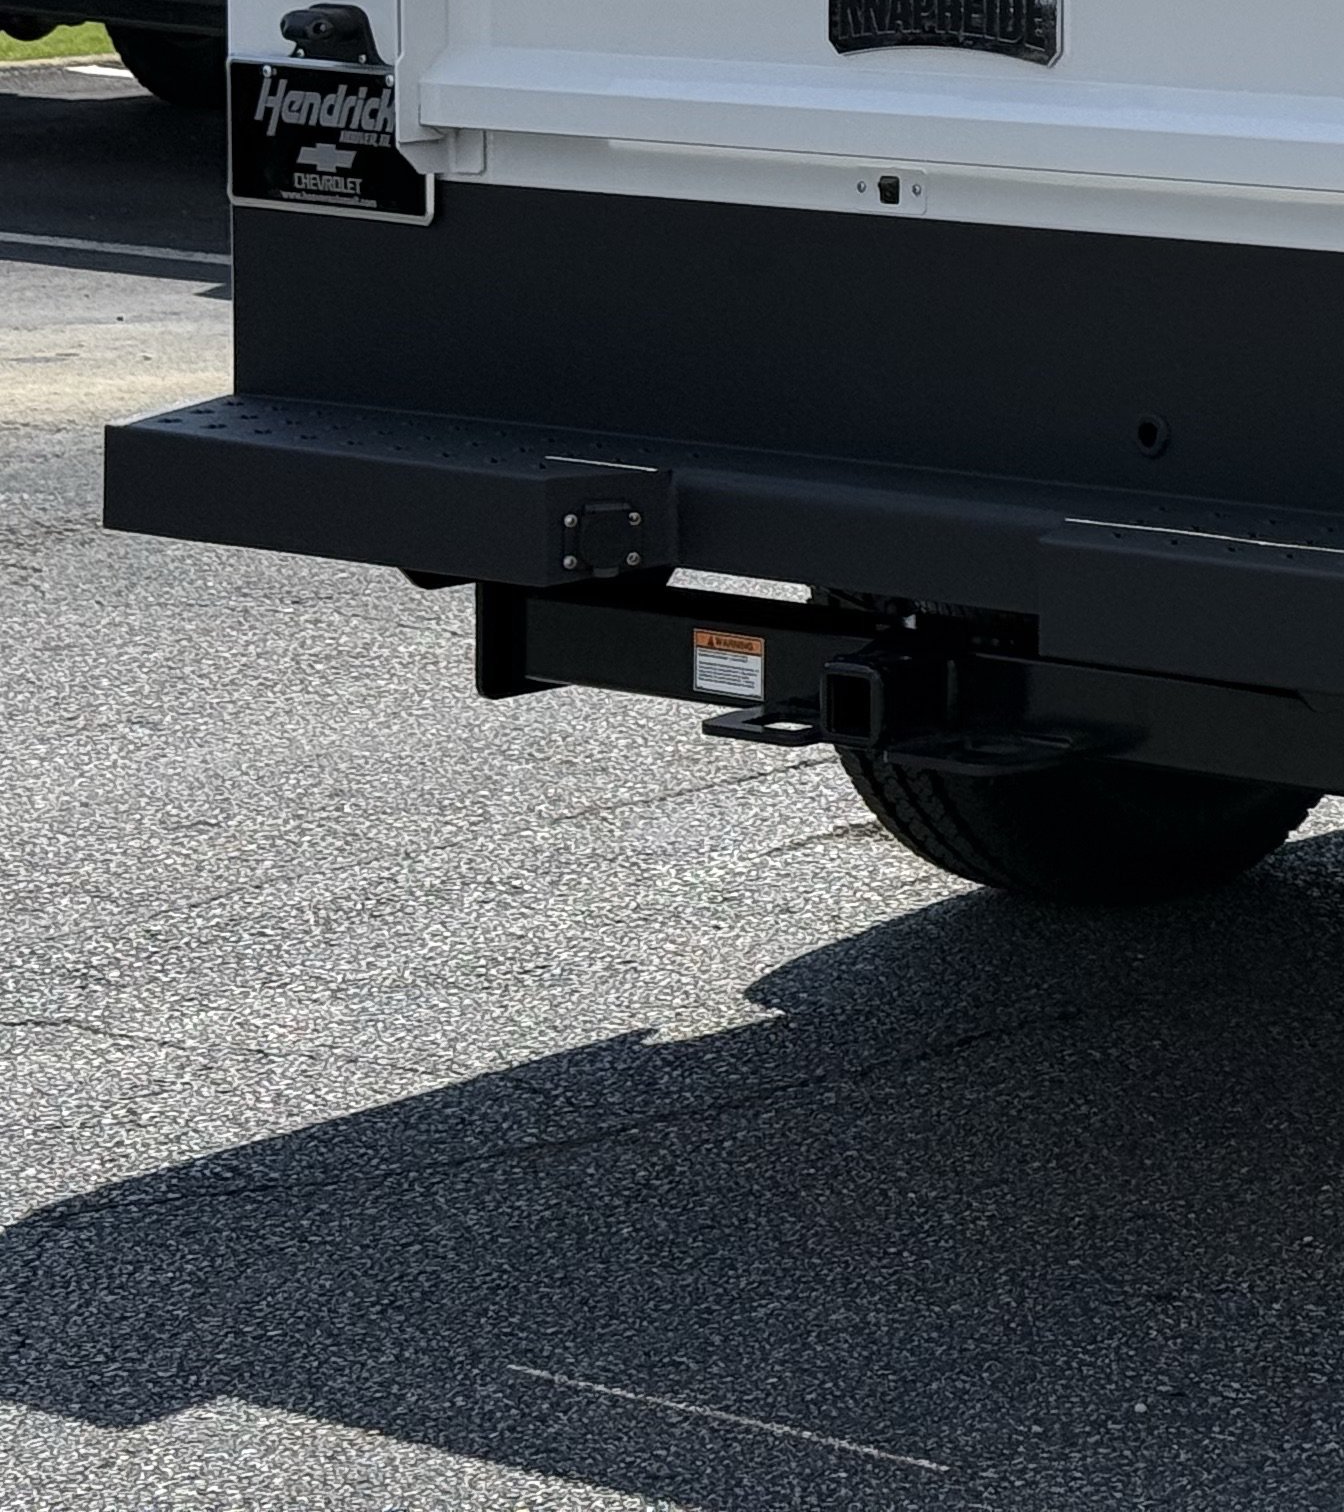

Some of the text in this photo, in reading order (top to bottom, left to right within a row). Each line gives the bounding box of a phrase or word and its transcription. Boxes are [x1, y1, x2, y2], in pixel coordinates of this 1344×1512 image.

[254, 77, 395, 137] Hendrick
[293, 172, 363, 194] CHEVROLET
[714, 636, 754, 651] WARNING
